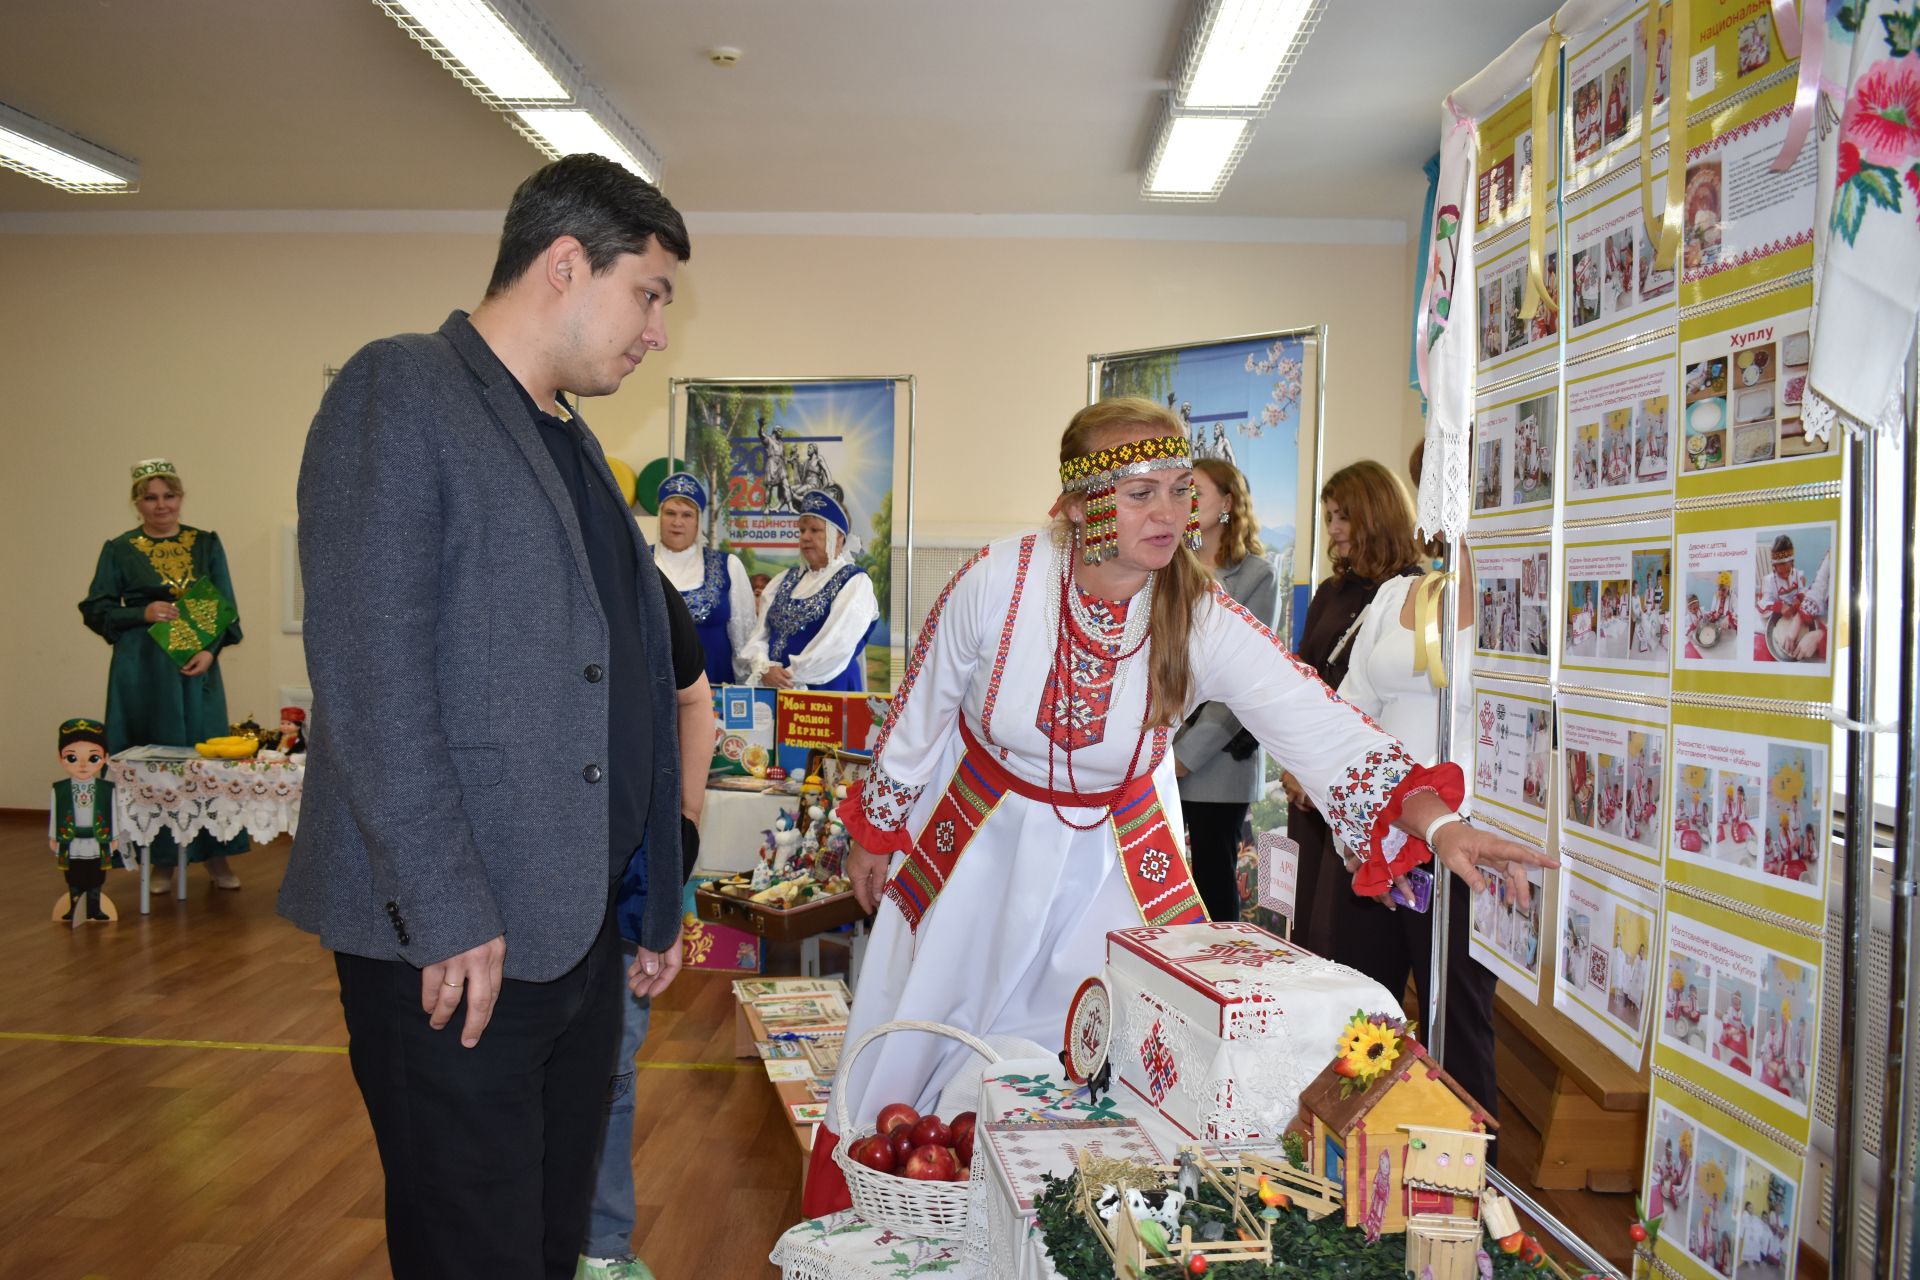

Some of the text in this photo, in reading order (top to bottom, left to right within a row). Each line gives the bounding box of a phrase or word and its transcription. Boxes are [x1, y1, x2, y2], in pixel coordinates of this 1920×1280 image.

[1730, 326, 1774, 347] Хуплу
[728, 475, 766, 508] 26
[752, 519, 800, 529] ЕДИНСТВ
[729, 530, 800, 540] НАРОДОВ РОС
[1671, 924, 1753, 964] Изготовление национального
